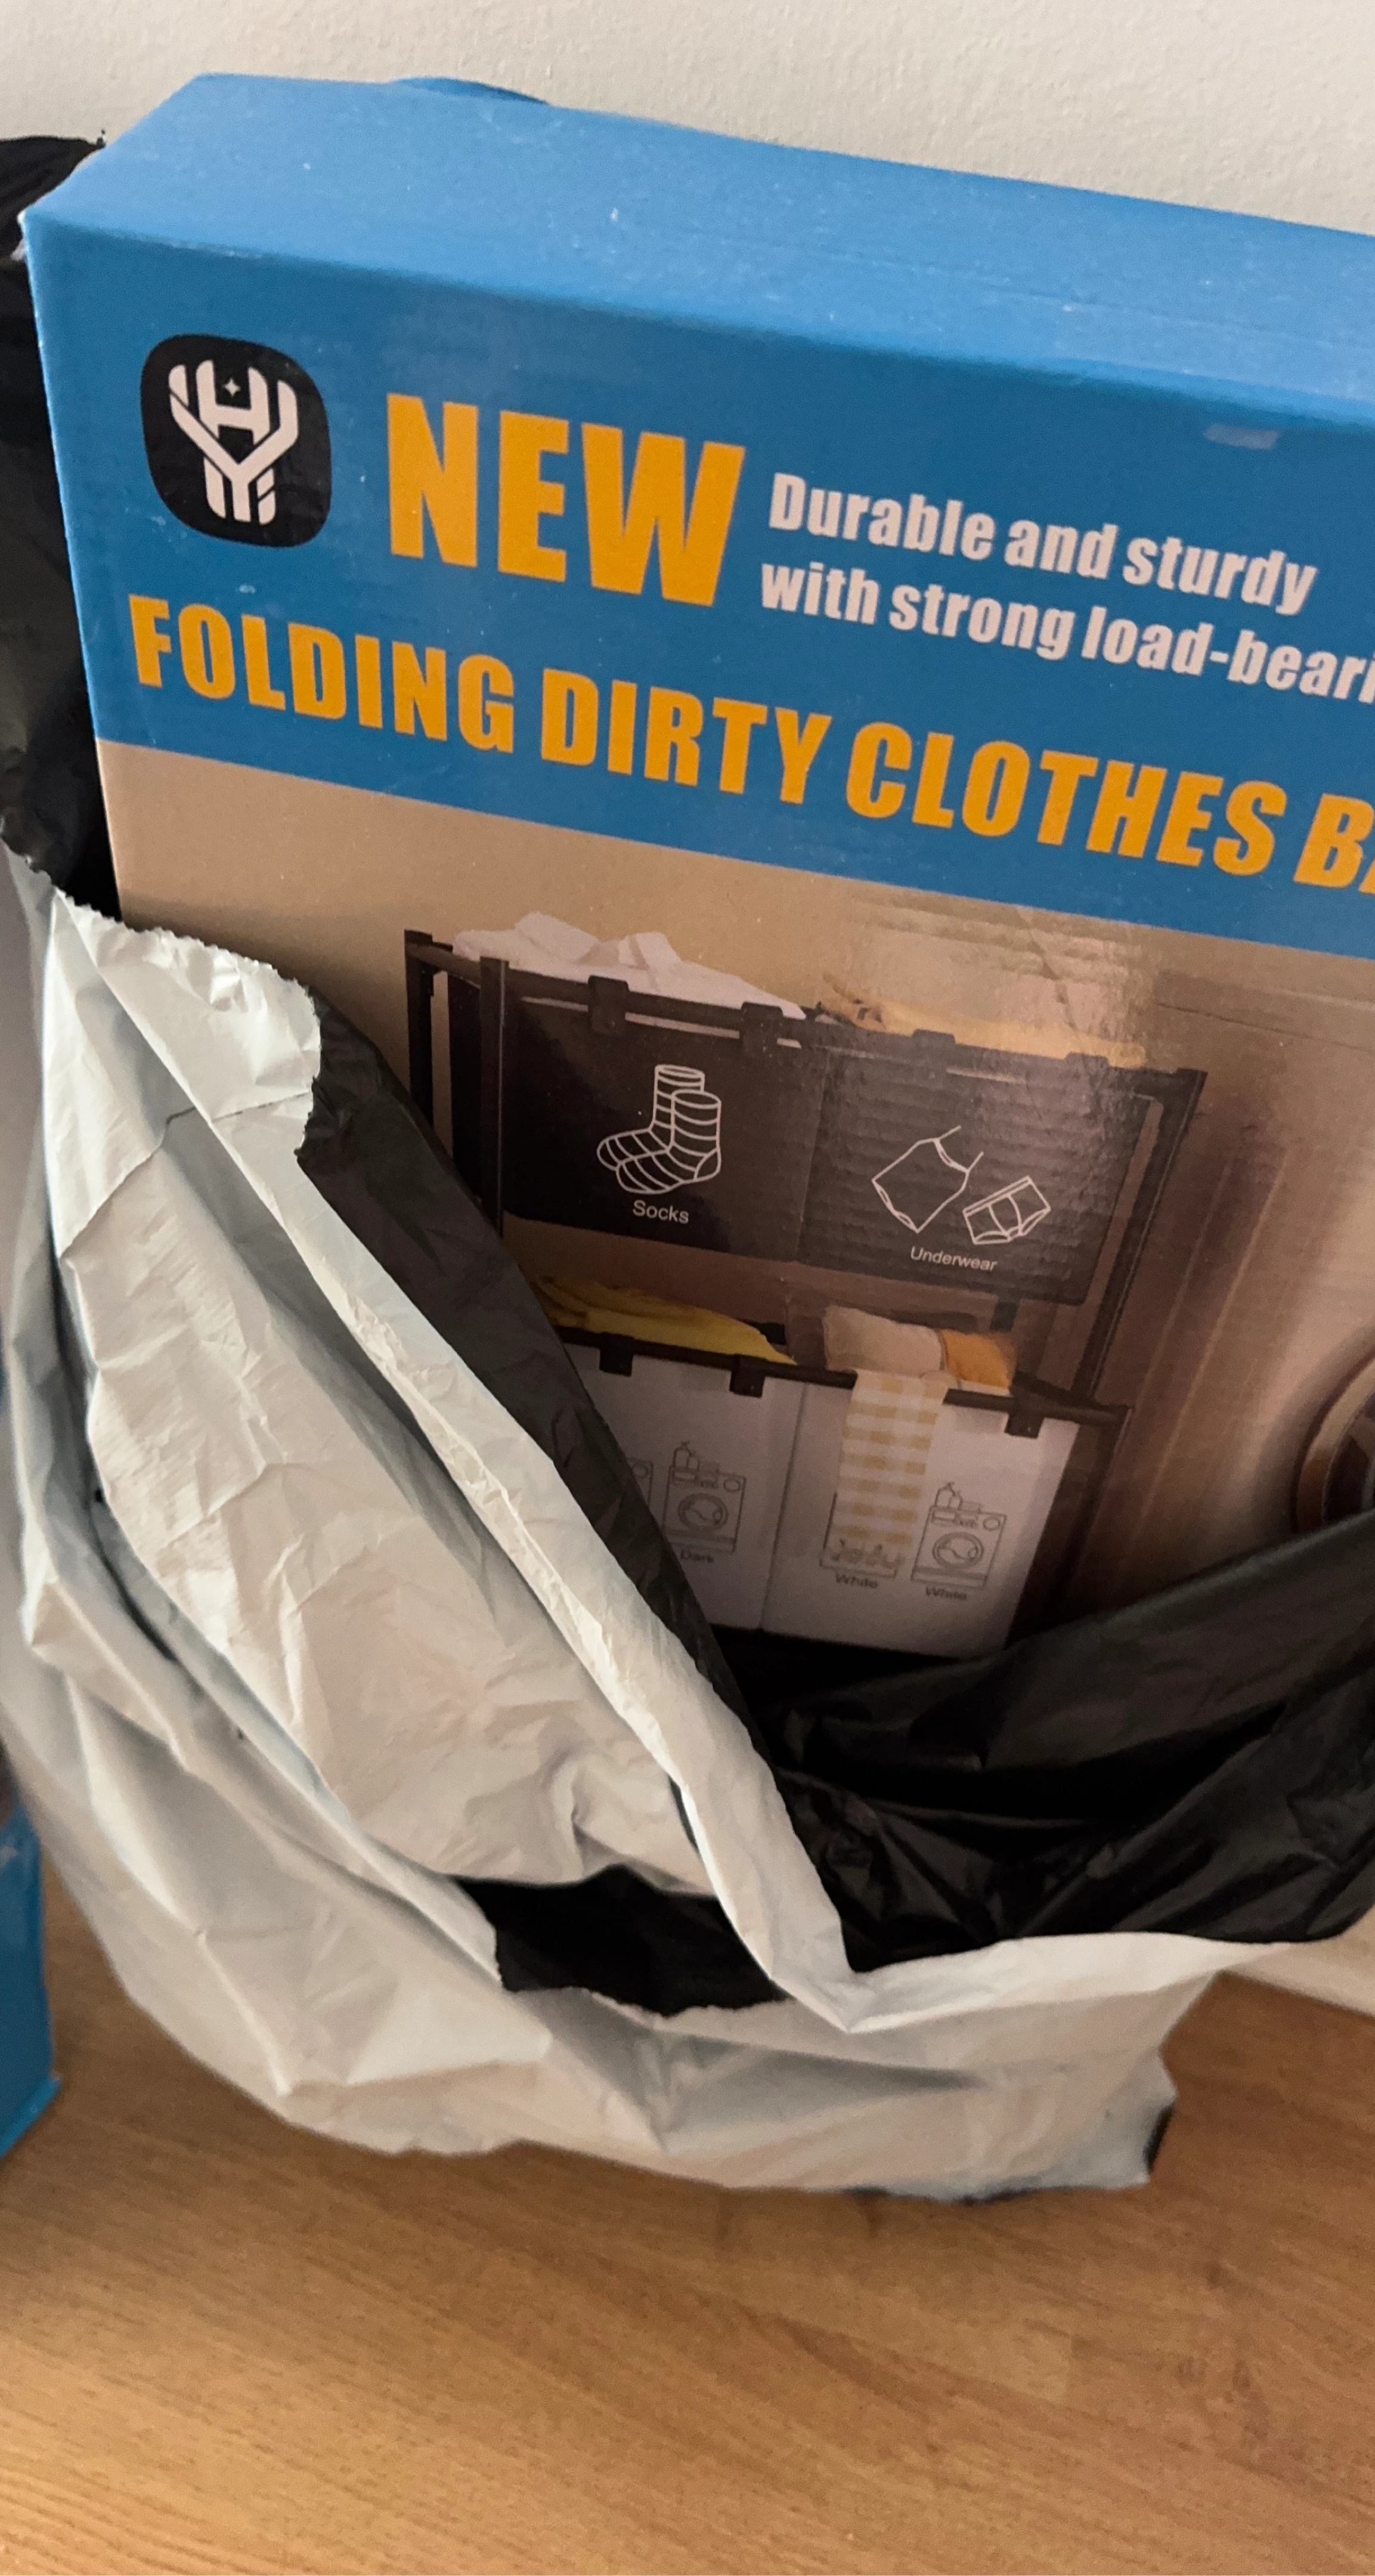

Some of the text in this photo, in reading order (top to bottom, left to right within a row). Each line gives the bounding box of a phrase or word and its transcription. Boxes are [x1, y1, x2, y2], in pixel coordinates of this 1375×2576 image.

[386, 392, 746, 606] NEW
[769, 472, 1317, 615] Durable and sturdy
[761, 562, 881, 625] with
[888, 583, 1075, 660] strong
[128, 593, 515, 754] FOLDING
[541, 667, 831, 804] DIRTY
[846, 722, 1287, 877] CLOTHES
[632, 1199, 689, 1225] Socks
[911, 1247, 998, 1272] Underwear
